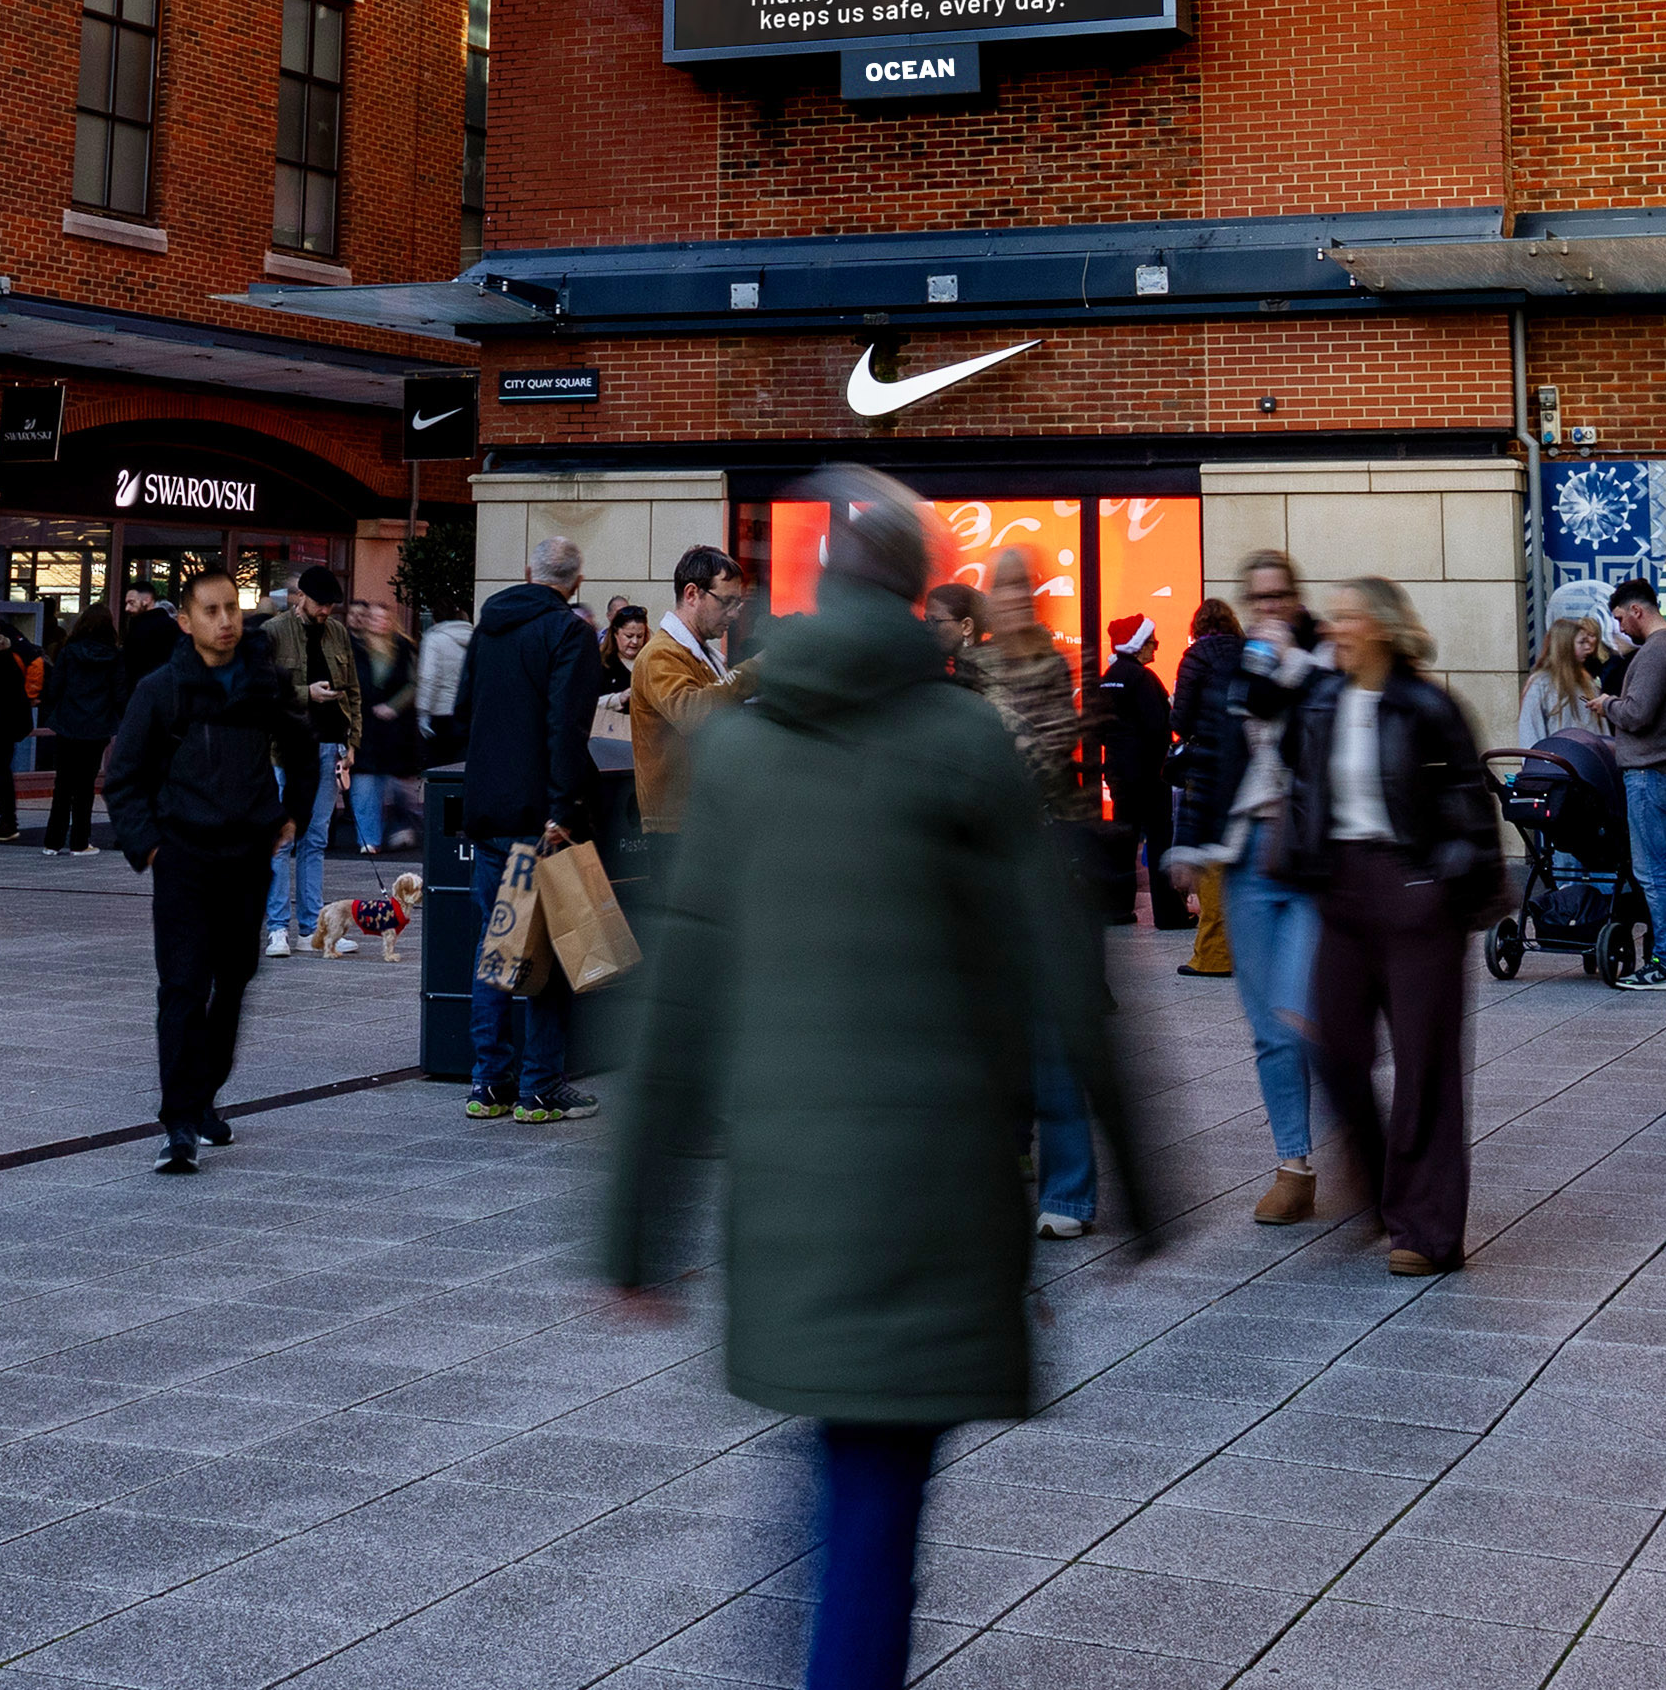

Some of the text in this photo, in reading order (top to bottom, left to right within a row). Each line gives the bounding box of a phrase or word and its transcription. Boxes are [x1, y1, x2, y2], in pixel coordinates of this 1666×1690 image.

[760, 8, 830, 31] keeps
[837, 7, 865, 25] us
[865, 57, 956, 82] OCEAN
[504, 377, 592, 389] CITY QUAY SQUARE
[4, 430, 52, 441] SWAROVSKI
[144, 474, 256, 511] SWAROVSKI
